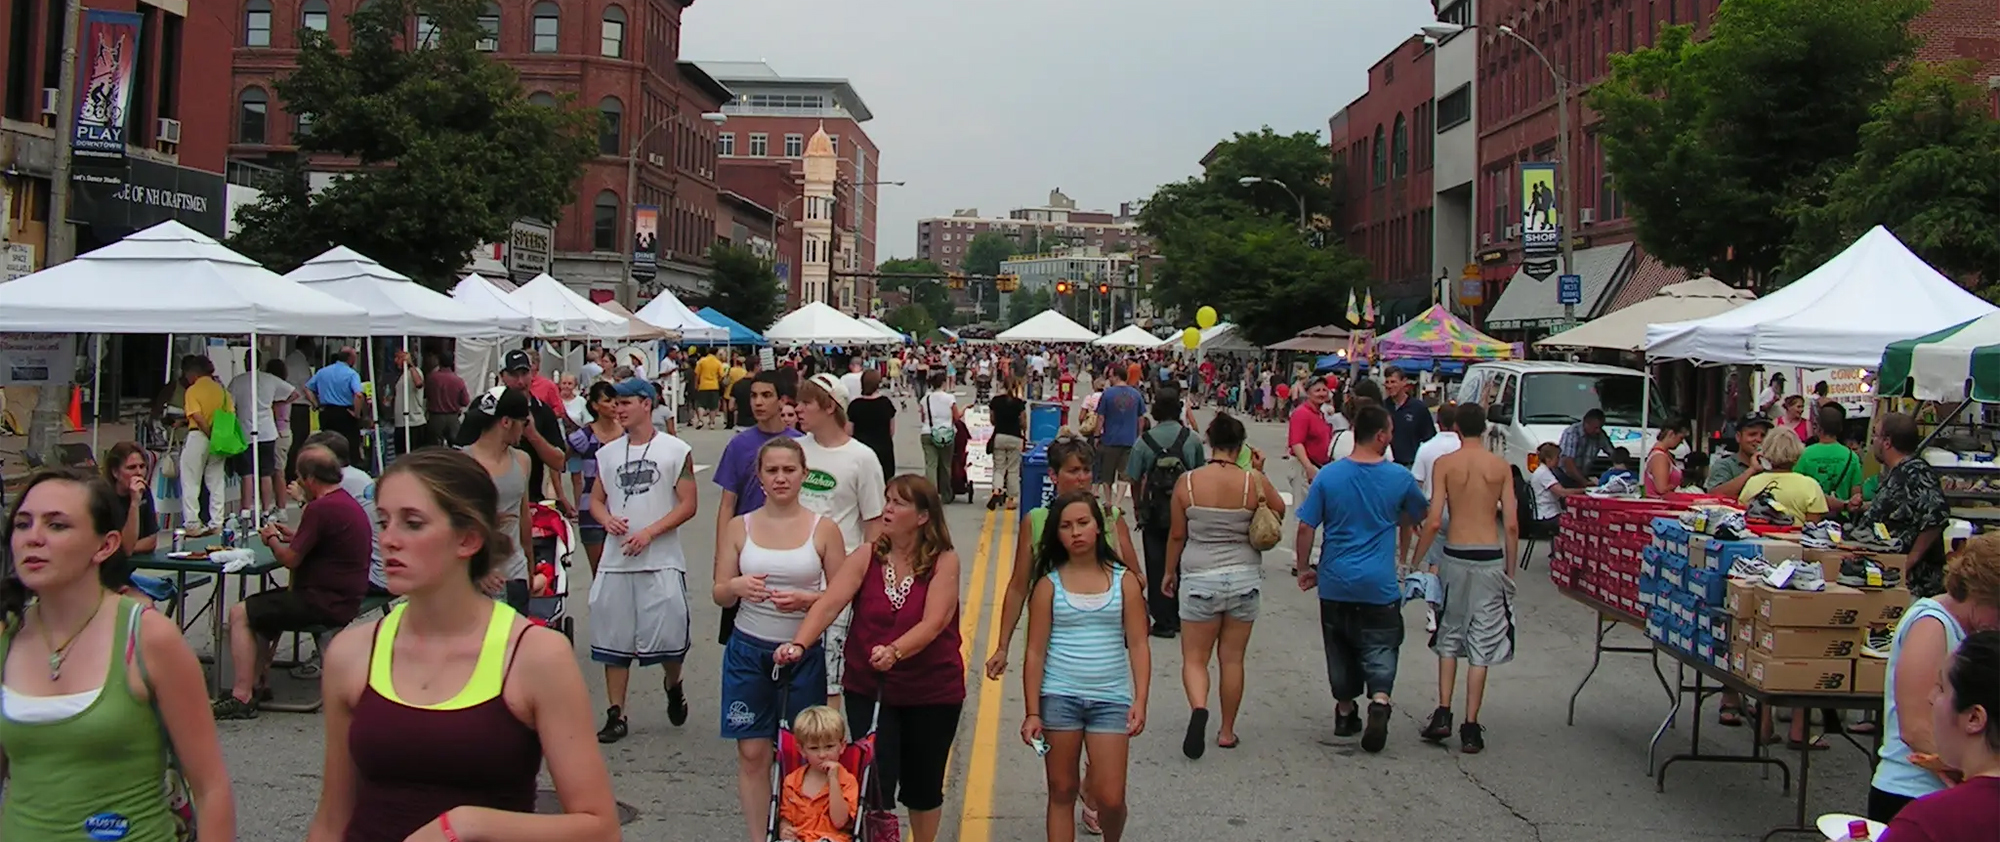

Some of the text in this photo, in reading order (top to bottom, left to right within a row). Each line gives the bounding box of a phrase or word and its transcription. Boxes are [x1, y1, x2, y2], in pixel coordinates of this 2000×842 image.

[76, 126, 122, 141] PLAY
[75, 140, 122, 150] DOWNTOWN
[132, 185, 144, 202] OF
[145, 188, 160, 205] NH
[160, 190, 208, 213] CRAFTSMEN
[1525, 233, 1557, 242] SHOP
[634, 251, 656, 260] DINE
